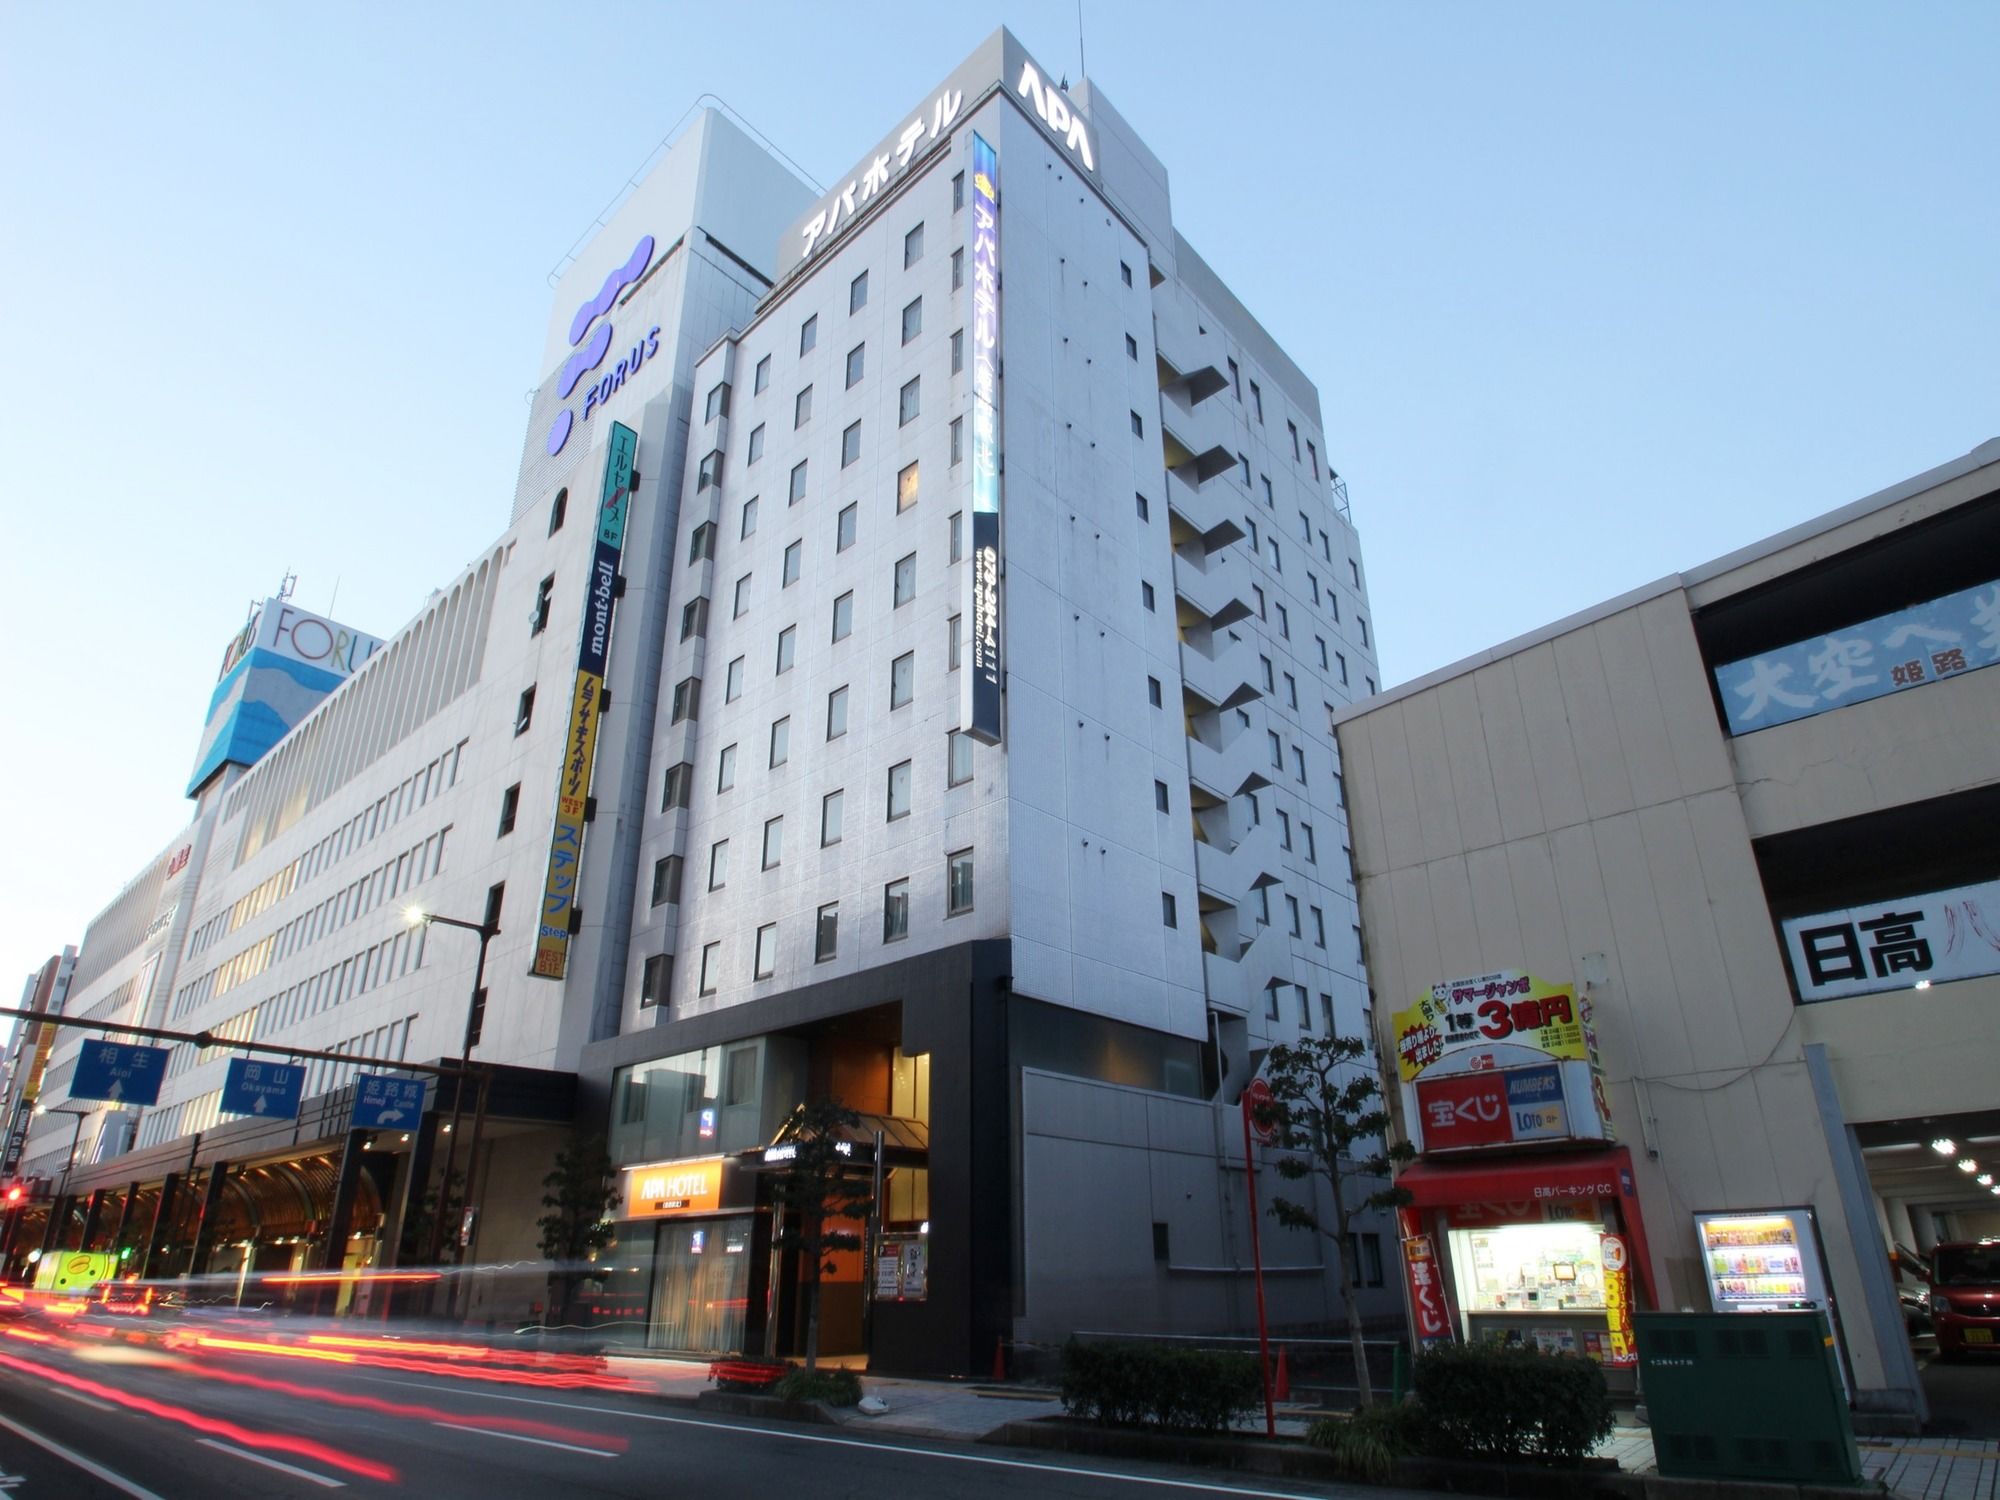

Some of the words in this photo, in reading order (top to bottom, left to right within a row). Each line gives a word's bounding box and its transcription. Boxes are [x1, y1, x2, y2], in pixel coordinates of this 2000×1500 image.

[1018, 62, 1094, 171] APA
[802, 89, 962, 258] アパホテル
[974, 204, 996, 349] アパホテル
[583, 325, 661, 421] FORUS
[983, 546, 997, 685] 079-284-4111
[273, 608, 382, 673] FORU
[1890, 647, 1967, 687] 姫路
[569, 677, 594, 796] ムラサキスポーツ
[561, 796, 583, 809] WEST
[564, 805, 580, 816] 3F
[548, 824, 578, 913] ステップ
[541, 926, 567, 940] Step
[1800, 911, 1934, 987] 日高
[538, 949, 564, 963] WEST
[538, 961, 560, 974] B1F
[1452, 976, 1531, 1005] サマージャンボ
[1478, 995, 1572, 1040] 3億円
[99, 1047, 151, 1069] 相生
[244, 1064, 289, 1085] 岡山
[241, 1081, 286, 1096] Okayama
[363, 1095, 386, 1106] Himeji
[1428, 1094, 1500, 1127] 宝くじ
[642, 1178, 665, 1199] APA
[666, 1174, 708, 1197] HOTEL
[1533, 1184, 1594, 1198] 日高パーキング
[1597, 1183, 1612, 1194] CC
[1411, 1262, 1441, 1332] 宝くじ
